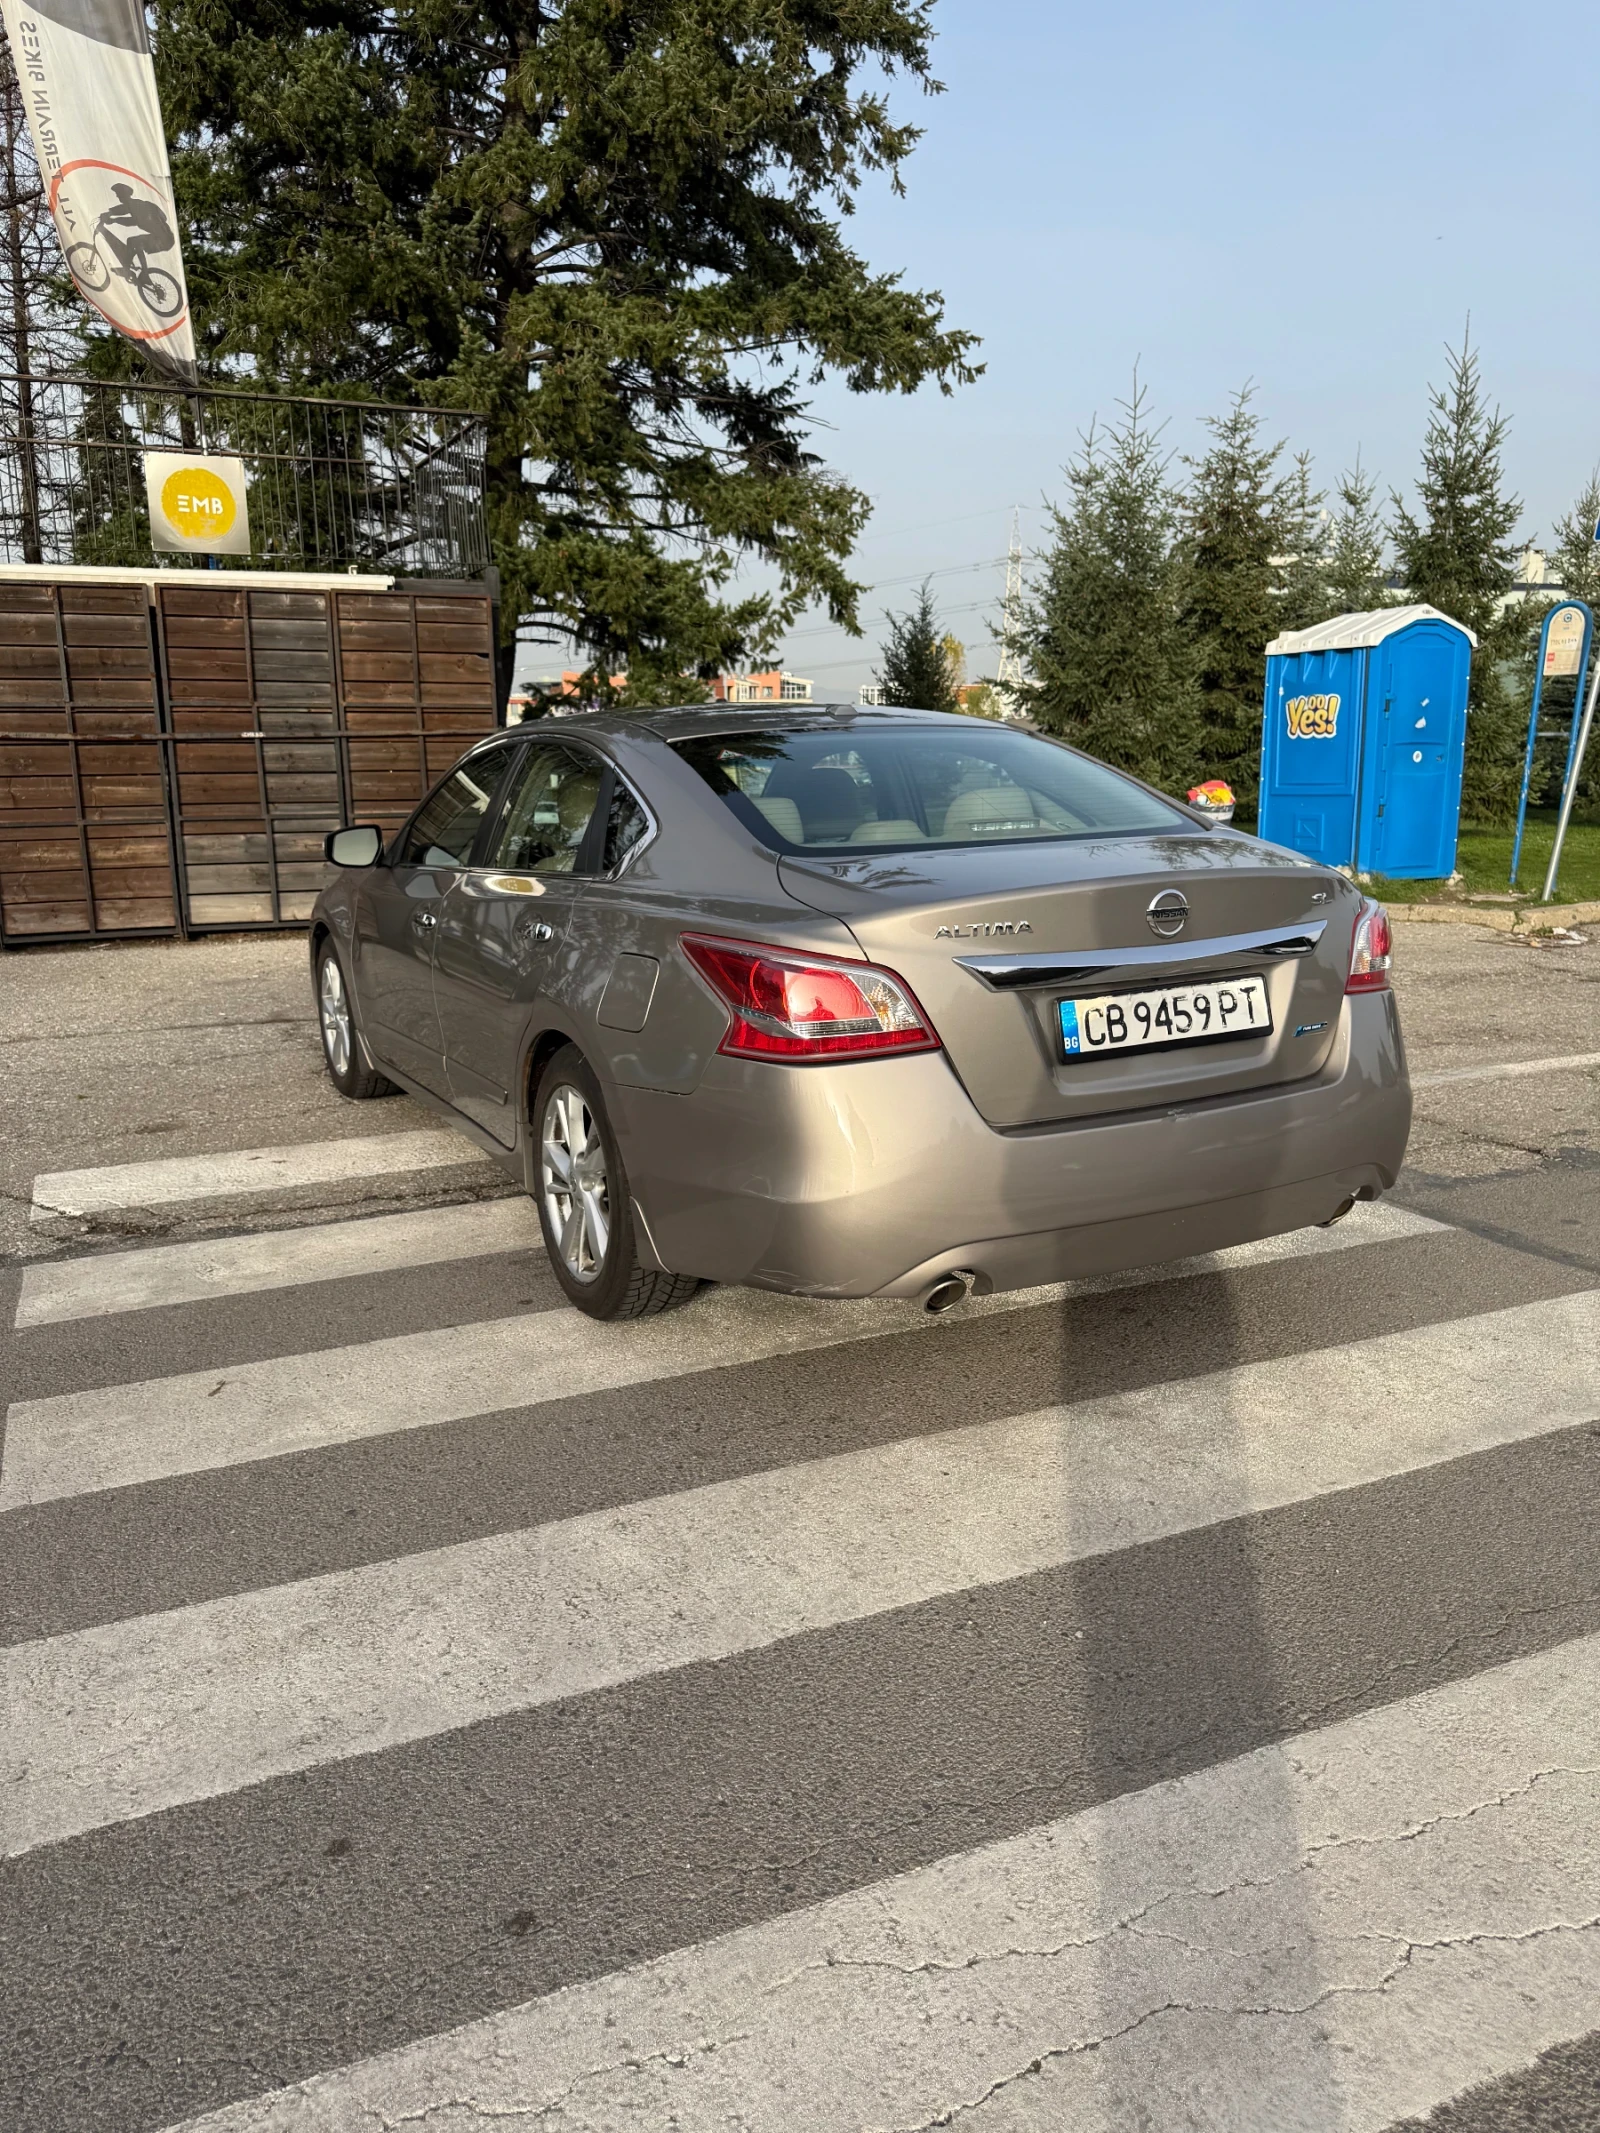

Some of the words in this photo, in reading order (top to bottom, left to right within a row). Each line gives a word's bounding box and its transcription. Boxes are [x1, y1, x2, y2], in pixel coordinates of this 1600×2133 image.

[177, 494, 223, 515] EMB
[1287, 695, 1339, 737] Yes!
[1151, 907, 1189, 919] NISSAN
[933, 920, 1034, 940] ALTIMA
[1063, 1036, 1079, 1050] BG
